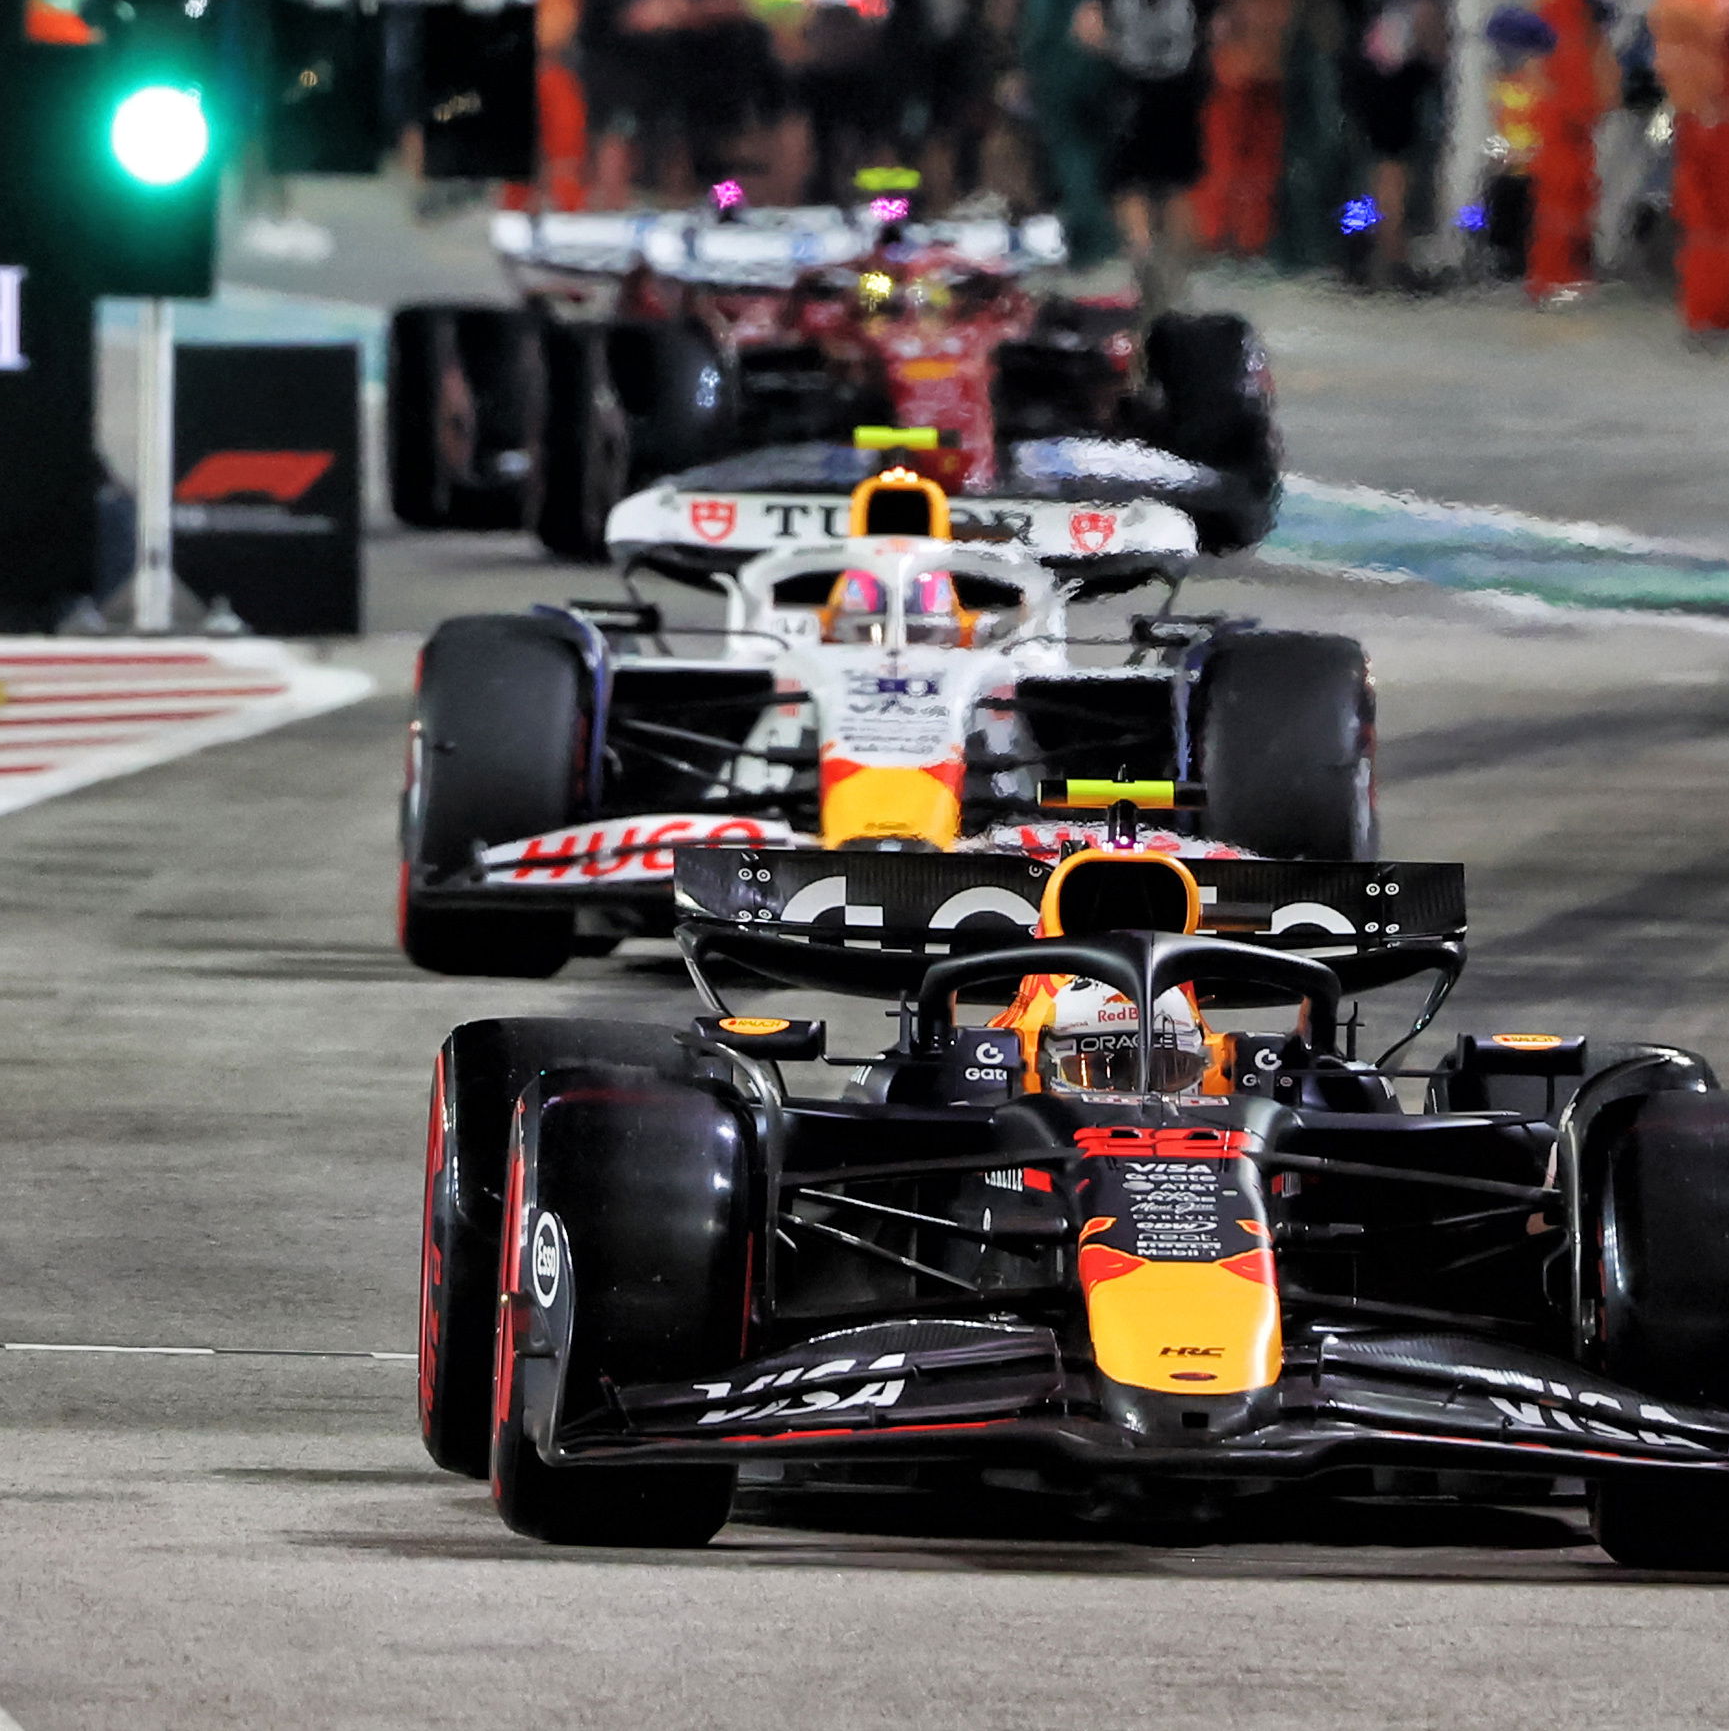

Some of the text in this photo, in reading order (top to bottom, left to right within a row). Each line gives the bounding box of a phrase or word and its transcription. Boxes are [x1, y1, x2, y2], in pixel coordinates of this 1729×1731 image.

[1125, 1162, 1212, 1174] VISA
[1159, 1182, 1219, 1191] AT&T
[537, 1235, 557, 1278] Esso
[1158, 1346, 1226, 1359] HRC
[692, 1353, 907, 1425] VISA
